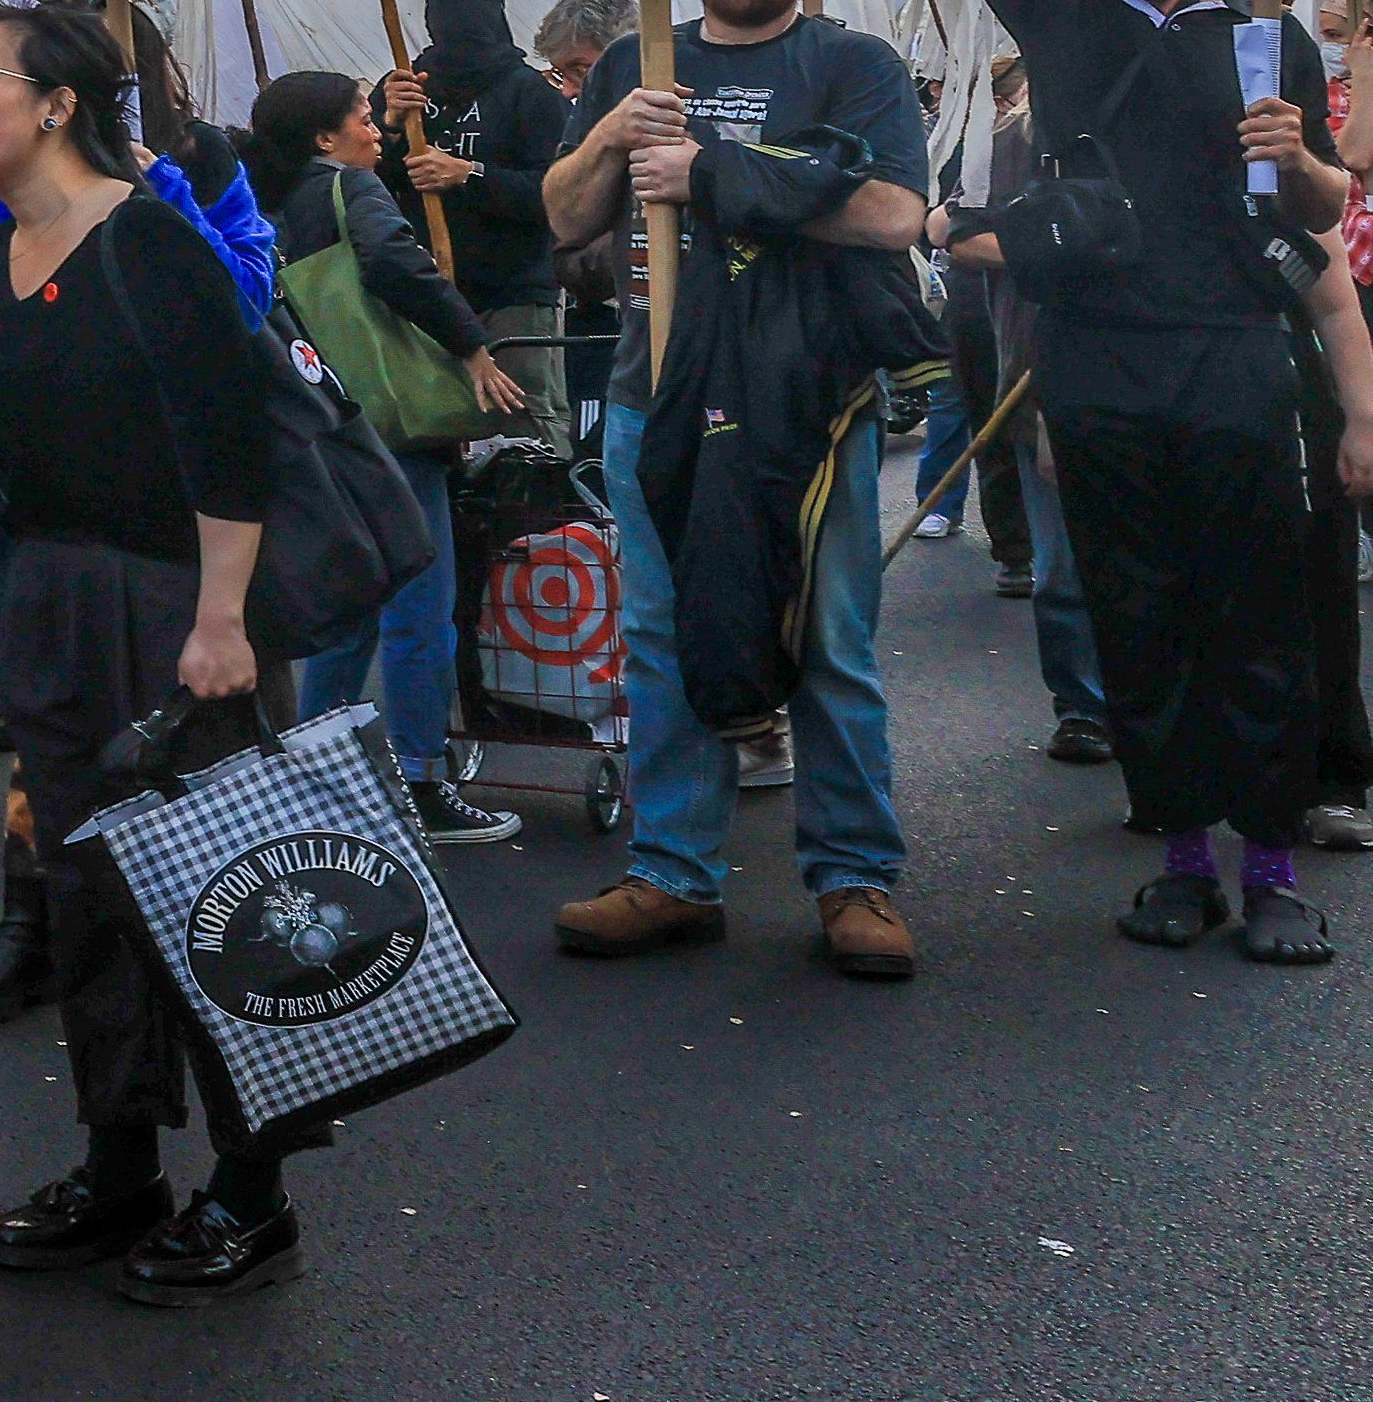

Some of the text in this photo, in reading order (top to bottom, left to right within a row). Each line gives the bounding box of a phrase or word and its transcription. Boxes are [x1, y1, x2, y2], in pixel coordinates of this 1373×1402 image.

[192, 839, 398, 953] MORTON WILLIAMS
[243, 931, 414, 1018] THE FRESH MARKETPLACE
